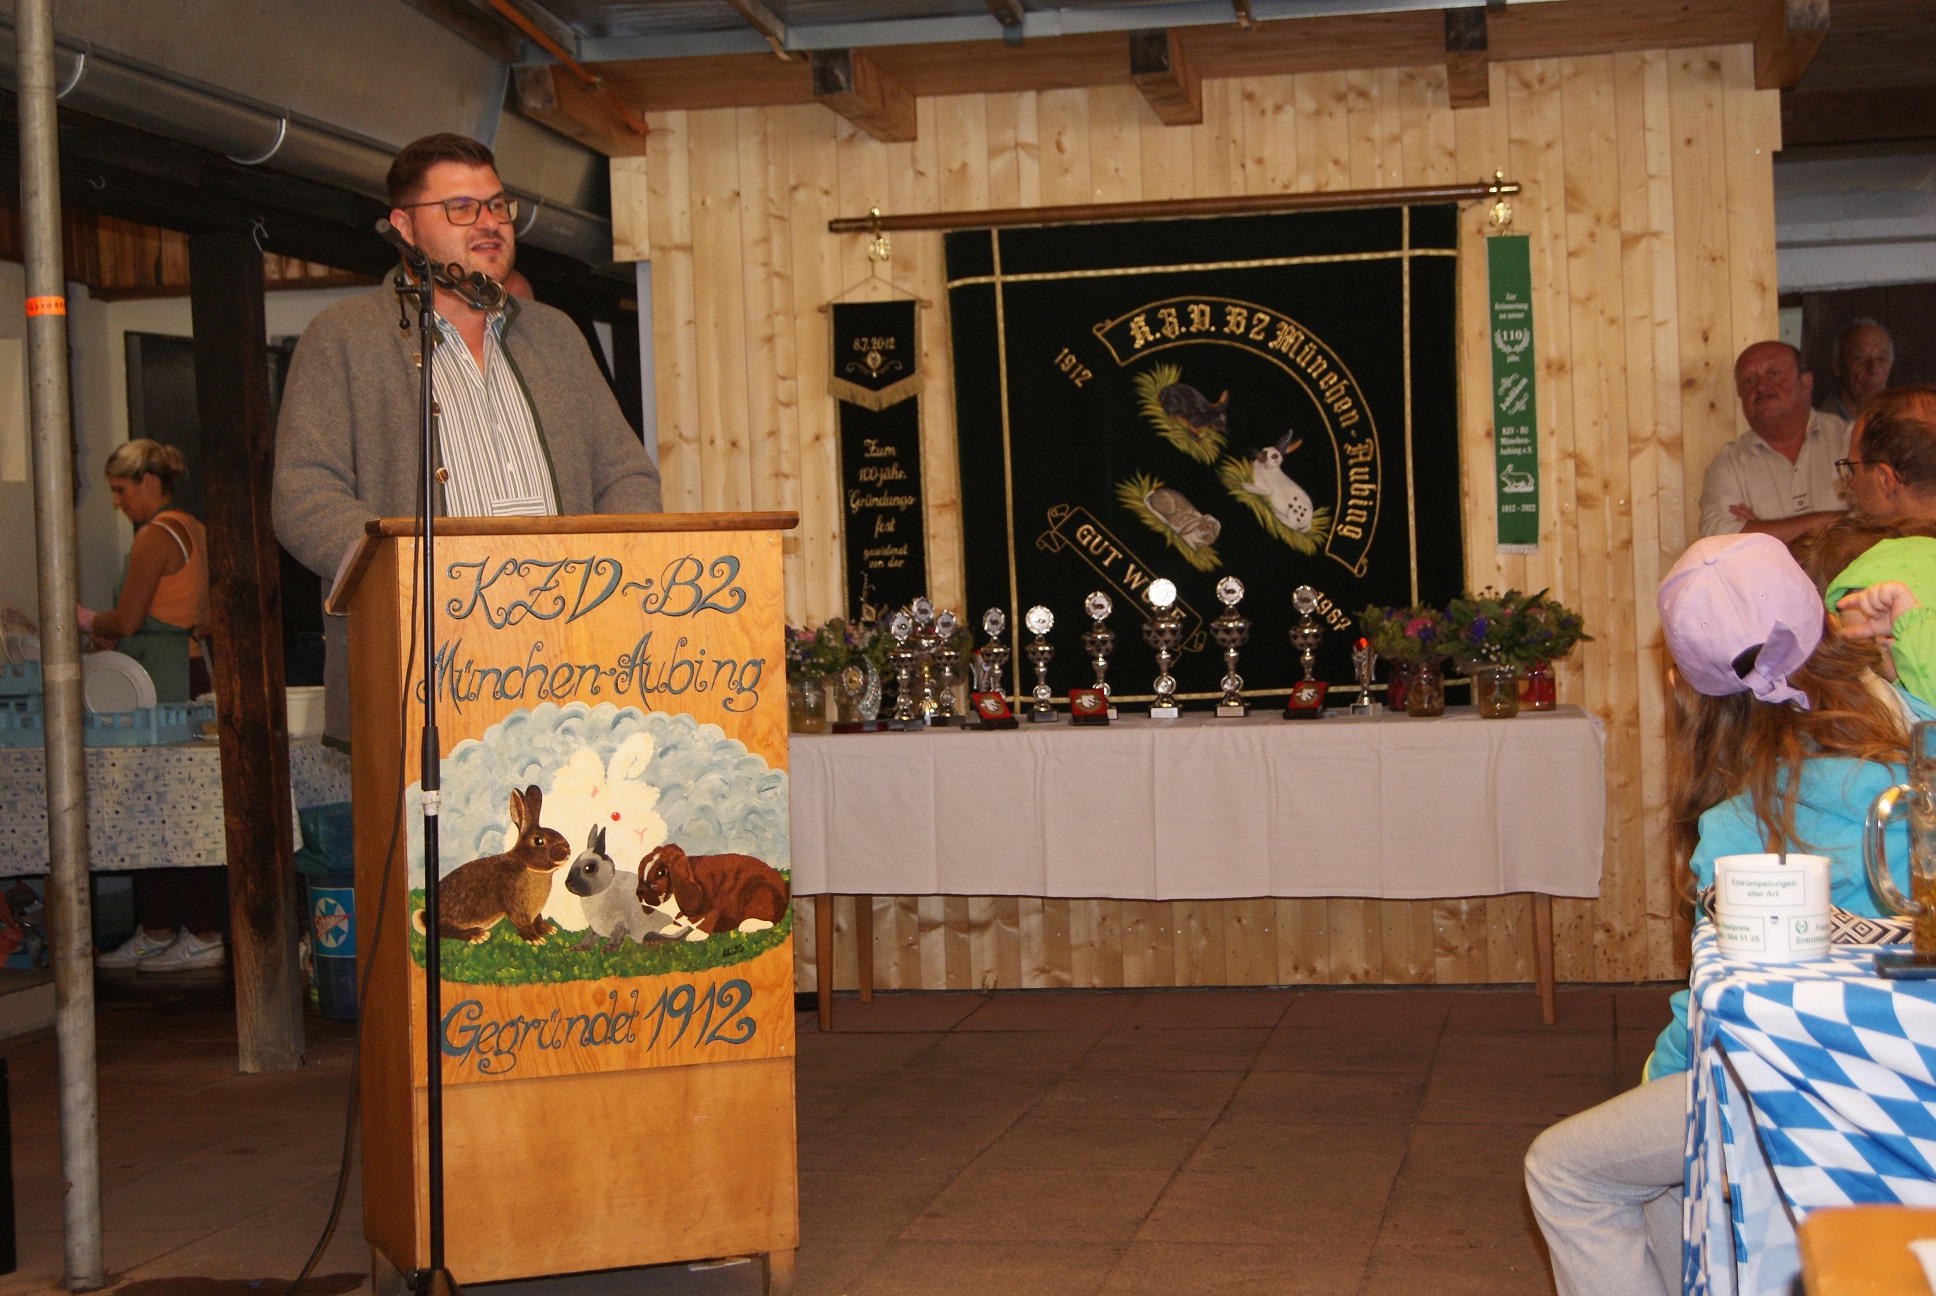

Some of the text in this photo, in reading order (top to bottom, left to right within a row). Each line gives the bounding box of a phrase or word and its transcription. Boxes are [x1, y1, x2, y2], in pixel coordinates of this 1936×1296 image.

[1502, 330, 1523, 341] 110
[1054, 347, 1093, 388] 1912
[863, 438, 897, 458] Zum
[1076, 524, 1123, 567] GUT
[1731, 878, 1796, 888] Entrümpelungen
[440, 979, 757, 1075] Gegründet 1912
